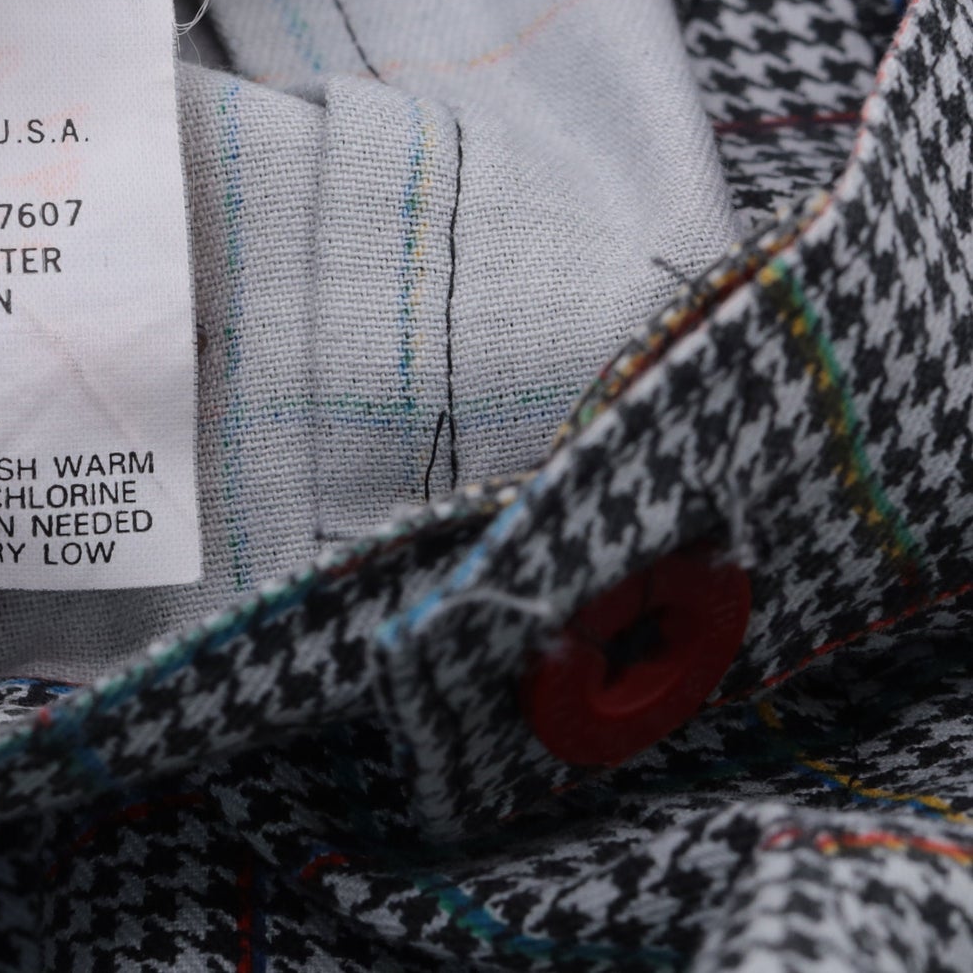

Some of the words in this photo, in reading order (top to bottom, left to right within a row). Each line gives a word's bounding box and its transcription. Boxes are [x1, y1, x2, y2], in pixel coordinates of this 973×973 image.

[52, 450, 155, 479] WARM
[31, 509, 153, 538] NEEDED
[42, 540, 116, 566] LOW
